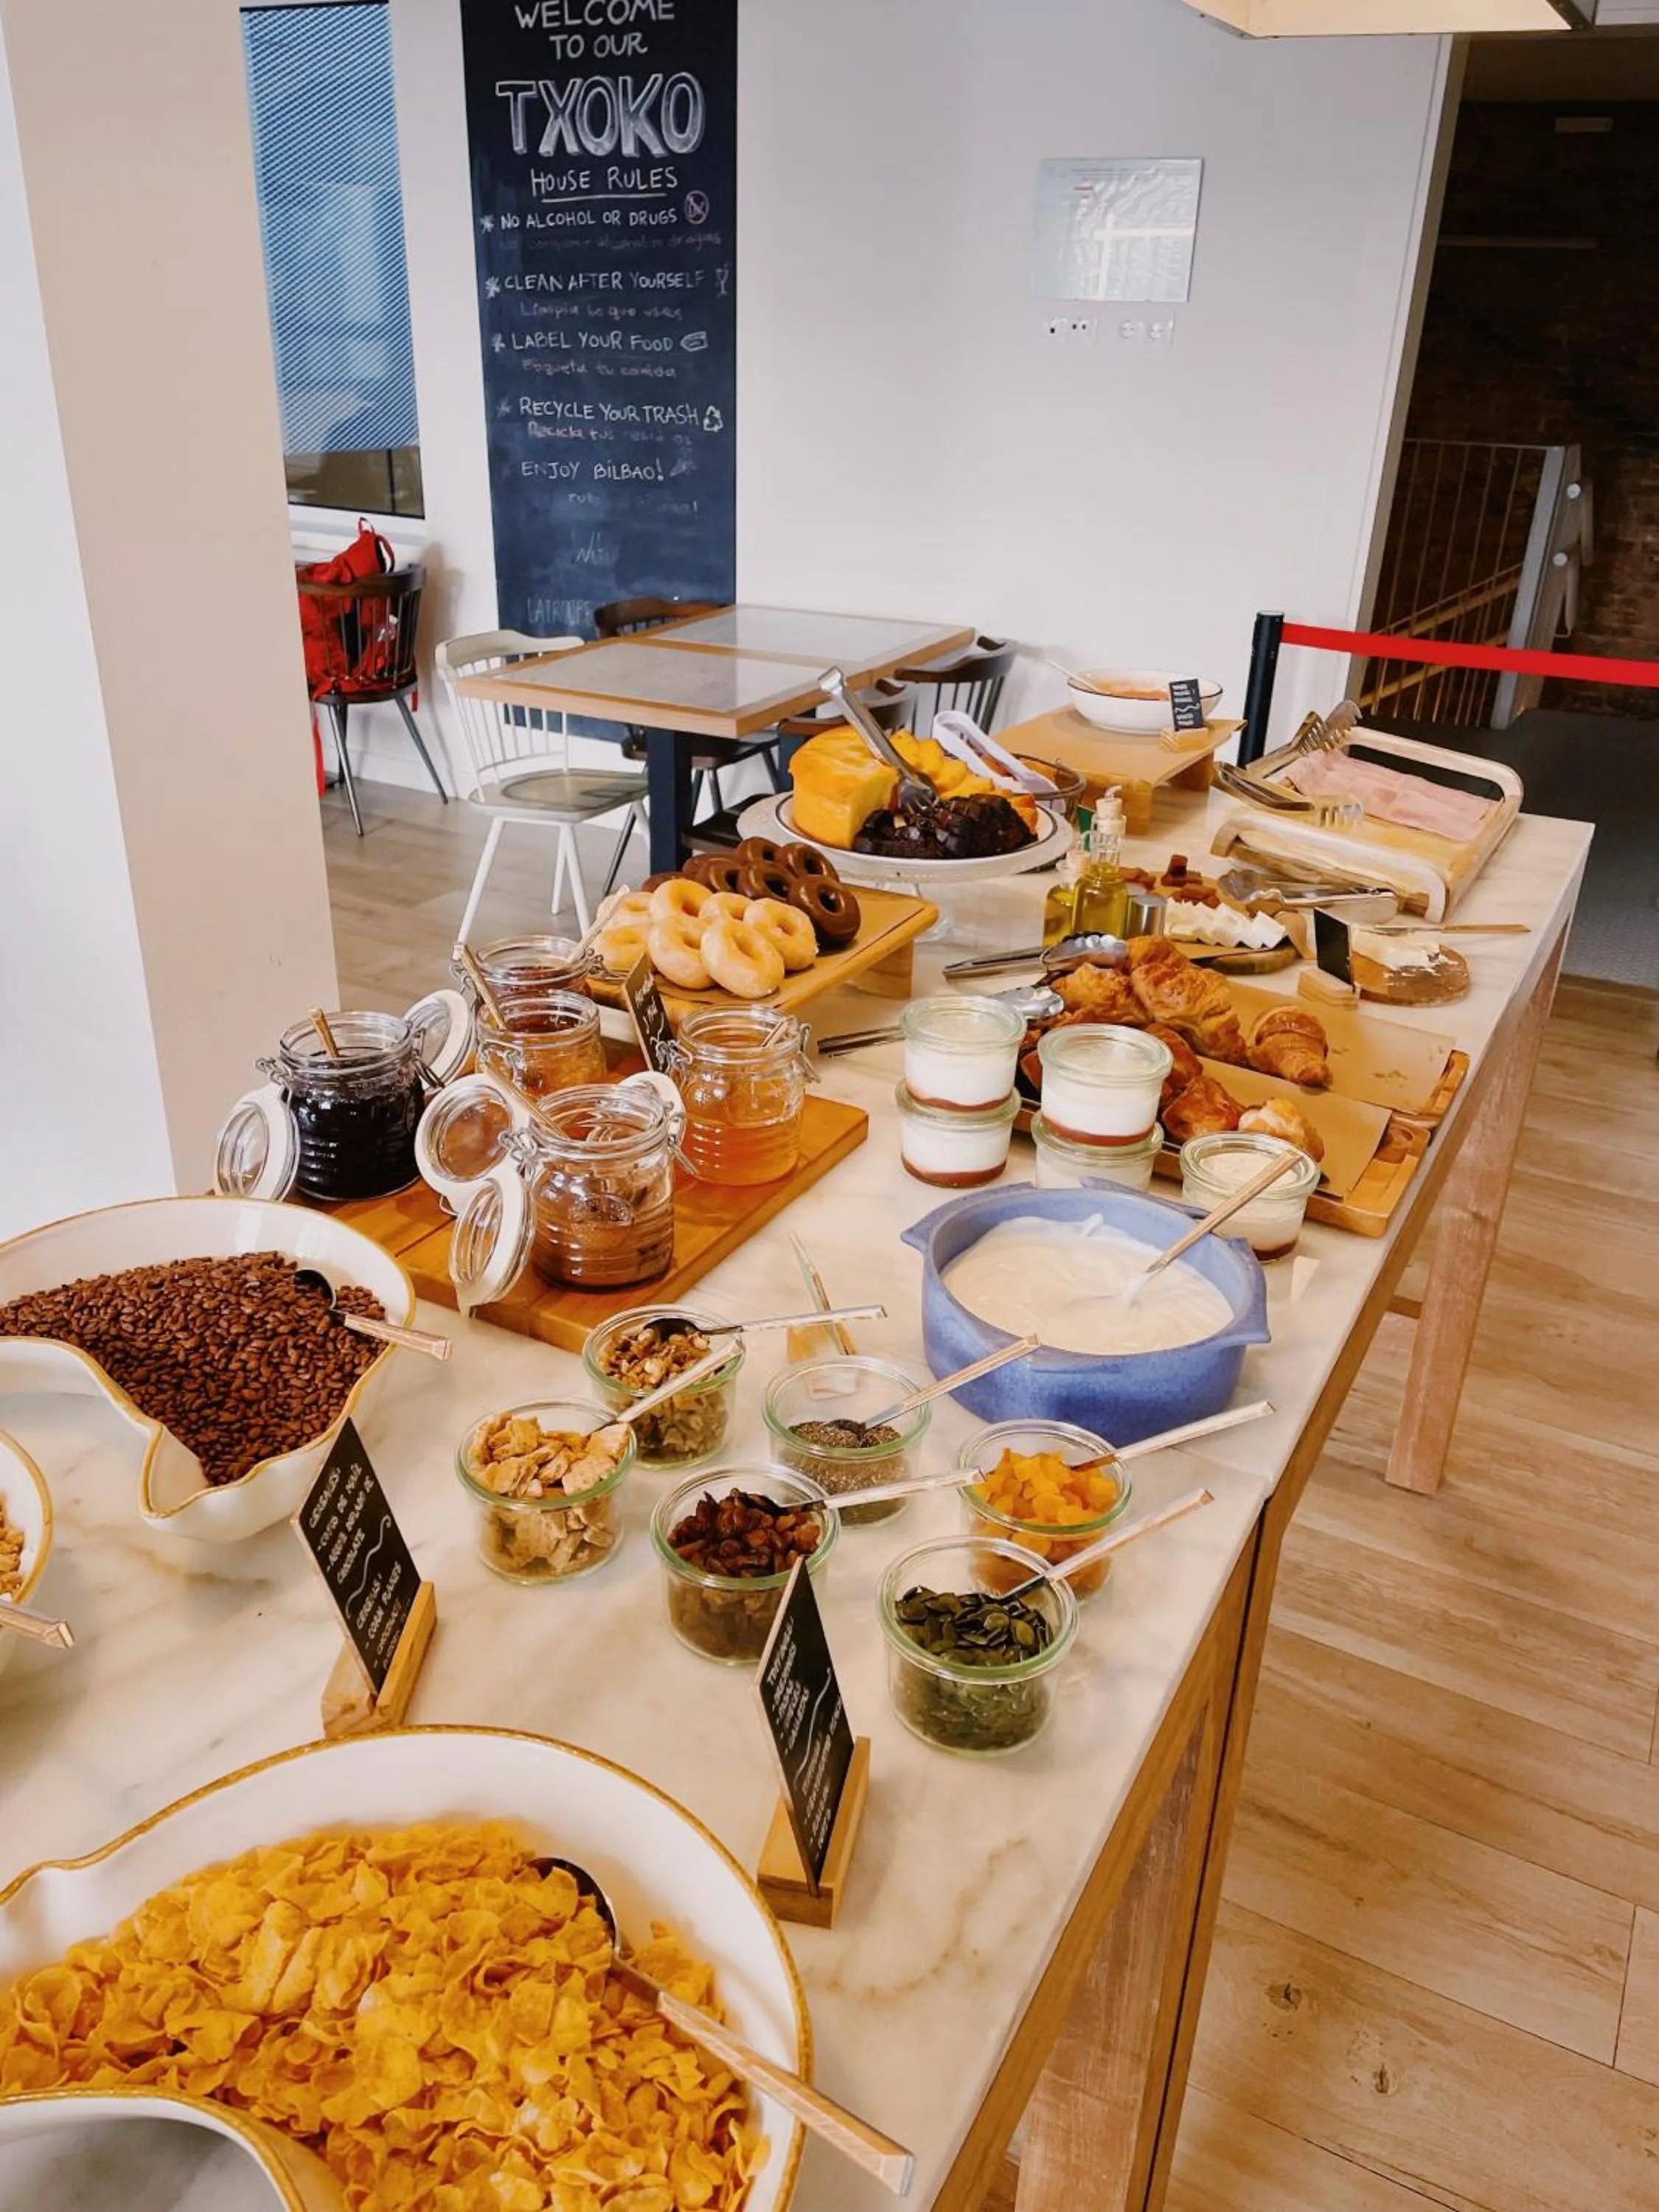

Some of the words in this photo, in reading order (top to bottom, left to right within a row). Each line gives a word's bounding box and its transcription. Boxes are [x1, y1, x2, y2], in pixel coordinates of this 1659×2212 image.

[515, 0, 675, 29] WELCOME
[549, 35, 585, 60] TO
[594, 32, 648, 58] OUR
[495, 72, 705, 158] TXOKO
[531, 168, 591, 197] HOUSE
[607, 167, 678, 191] RULES
[501, 213, 520, 230] NO
[526, 212, 596, 229] ALCOHOL
[602, 211, 622, 226] OR
[630, 209, 678, 226] DRUGS
[504, 273, 563, 291] CLEAN
[568, 271, 623, 291] AFTER
[512, 332, 571, 350] LABEL
[578, 331, 622, 350] YOUR
[630, 334, 673, 352] FOOD
[519, 396, 595, 420] RECYCLE
[599, 403, 640, 422] YOUR
[643, 403, 700, 425] TRASH
[522, 461, 580, 480] ENJOY
